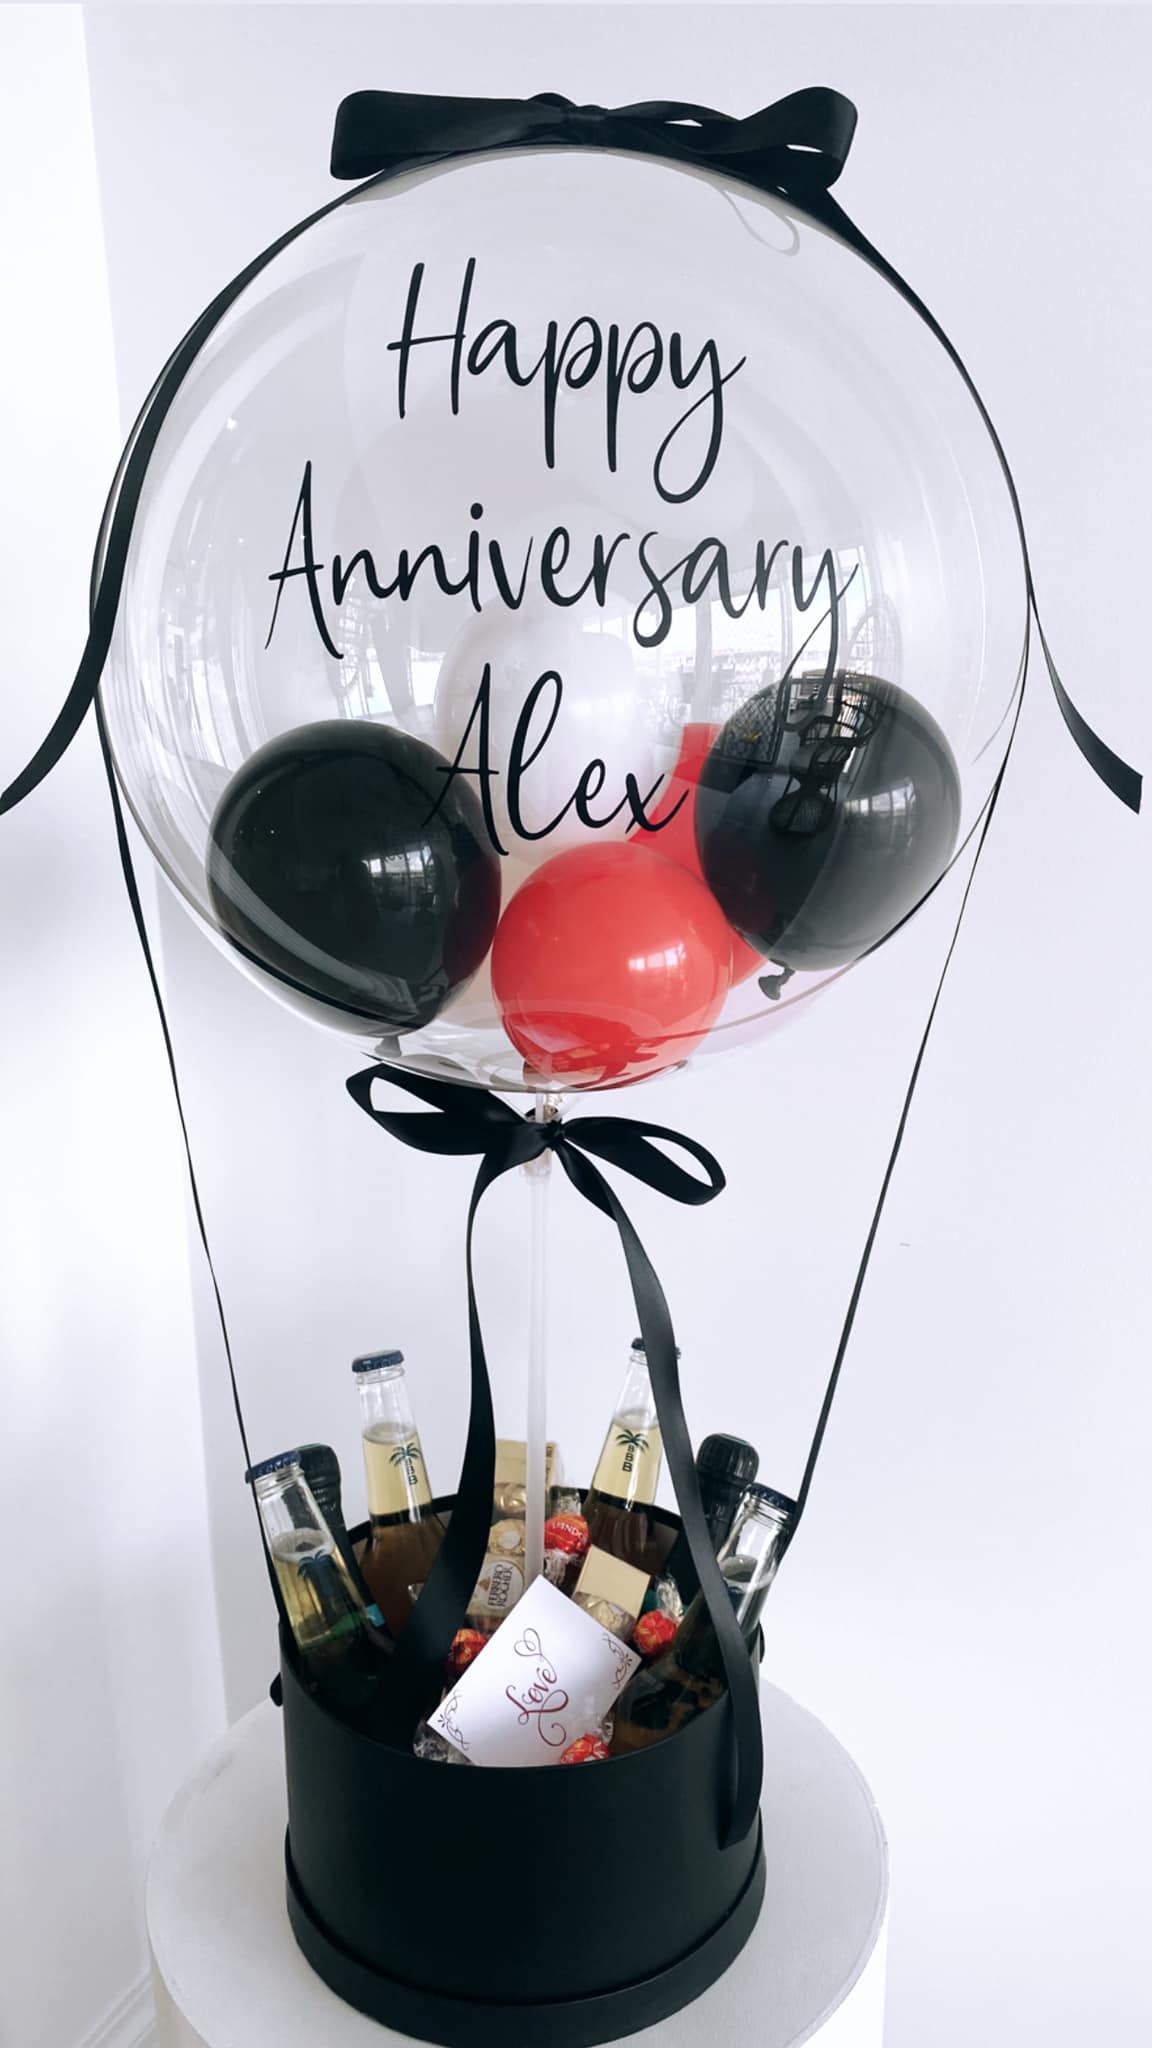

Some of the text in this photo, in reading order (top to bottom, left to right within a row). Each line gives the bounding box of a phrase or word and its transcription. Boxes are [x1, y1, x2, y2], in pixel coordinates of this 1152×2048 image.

[387, 257, 746, 503] Happy
[264, 460, 859, 732] Anniversary
[423, 662, 689, 856] Alex
[488, 1564, 503, 1606] FERRERO
[497, 1566, 514, 1607] ROCHER
[506, 1627, 569, 1747] Love
